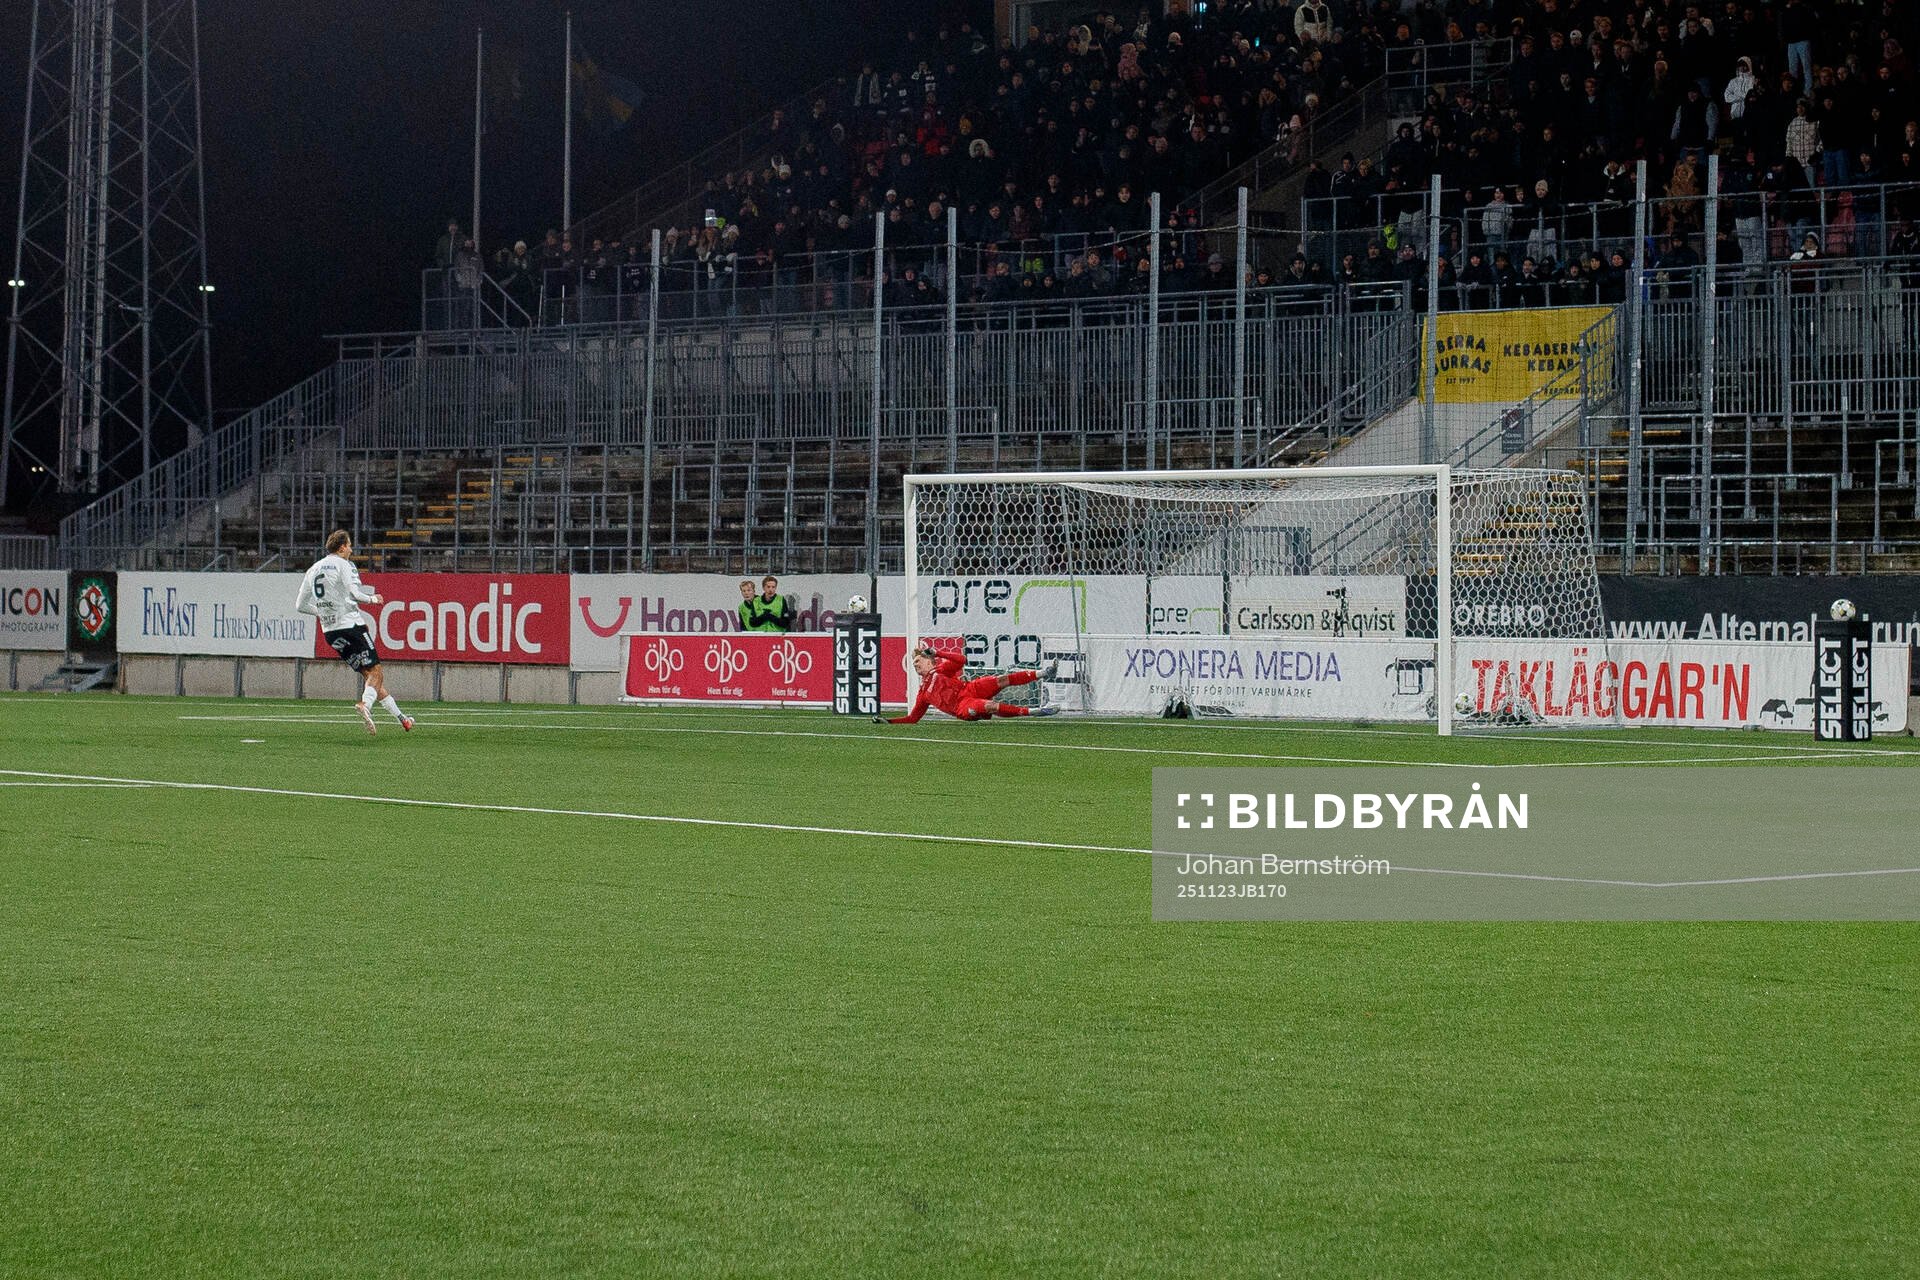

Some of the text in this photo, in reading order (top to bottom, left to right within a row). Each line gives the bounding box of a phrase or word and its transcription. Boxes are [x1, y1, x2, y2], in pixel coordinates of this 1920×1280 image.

[2, 587, 60, 616] ICON
[314, 573, 325, 599] 6
[1237, 605, 1315, 630] Carlsson
[644, 638, 684, 682] ÖBO
[704, 638, 748, 683] ÖBO
[768, 639, 812, 684] ÖBO
[835, 628, 850, 714] SELECT
[857, 628, 877, 714] SELECT
[1124, 648, 1342, 682] XPONERA MEDIA
[1819, 637, 1842, 740] SELECT
[1852, 637, 1869, 740] SELECT
